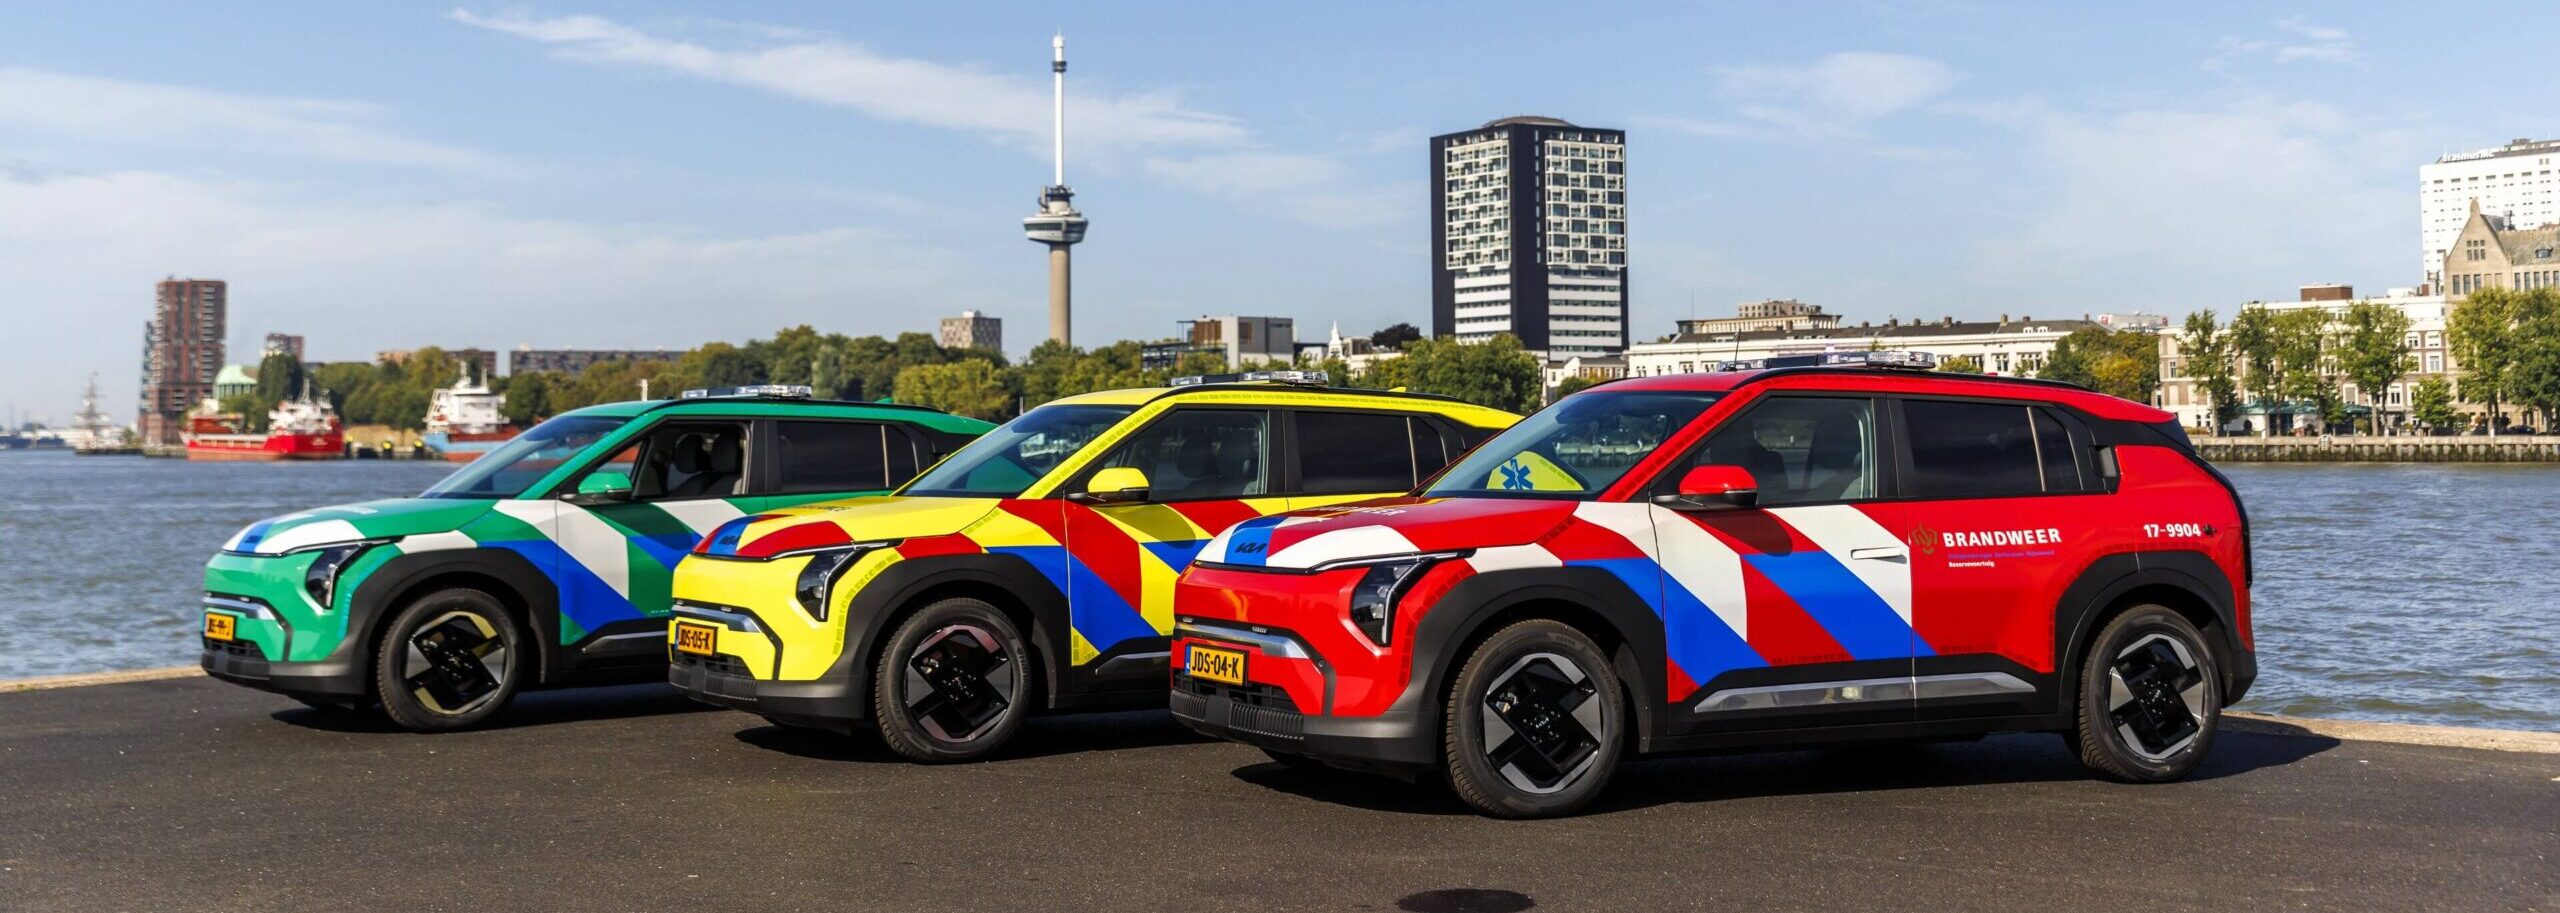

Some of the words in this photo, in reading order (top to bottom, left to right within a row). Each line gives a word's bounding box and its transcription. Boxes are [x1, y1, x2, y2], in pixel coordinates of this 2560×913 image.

[1942, 528, 2062, 548] BRANDWEER
[2143, 523, 2202, 538] 17-9904
[1235, 542, 1268, 553] KIA
[1191, 650, 1239, 680] JDS-04-K
